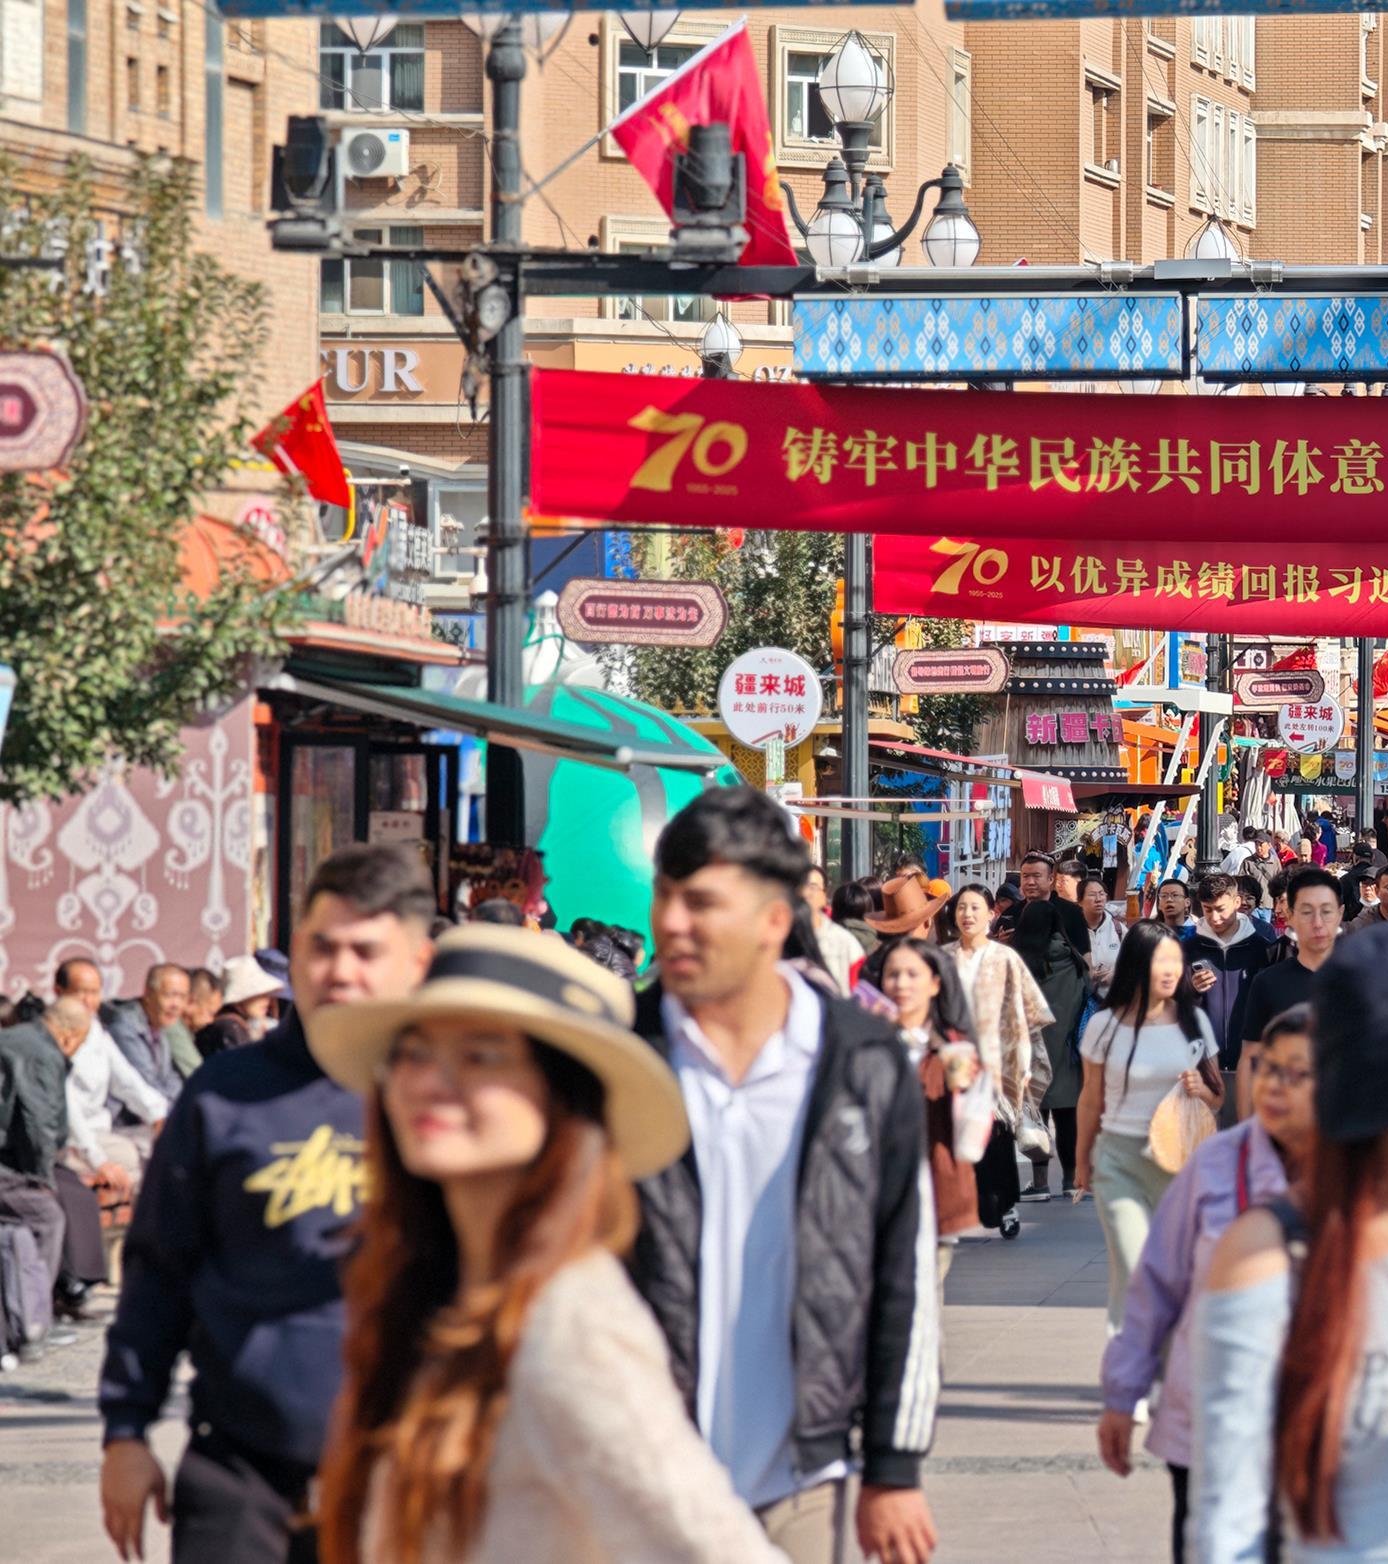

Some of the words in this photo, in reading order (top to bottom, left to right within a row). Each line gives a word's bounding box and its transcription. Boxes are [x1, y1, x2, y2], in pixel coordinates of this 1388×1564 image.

[320, 348, 424, 393] UR
[627, 404, 749, 492] 70
[929, 536, 1009, 595] 70
[735, 673, 806, 697] 疆来城
[733, 702, 806, 714] 此处前行50米
[1288, 704, 1334, 720] 疆来城
